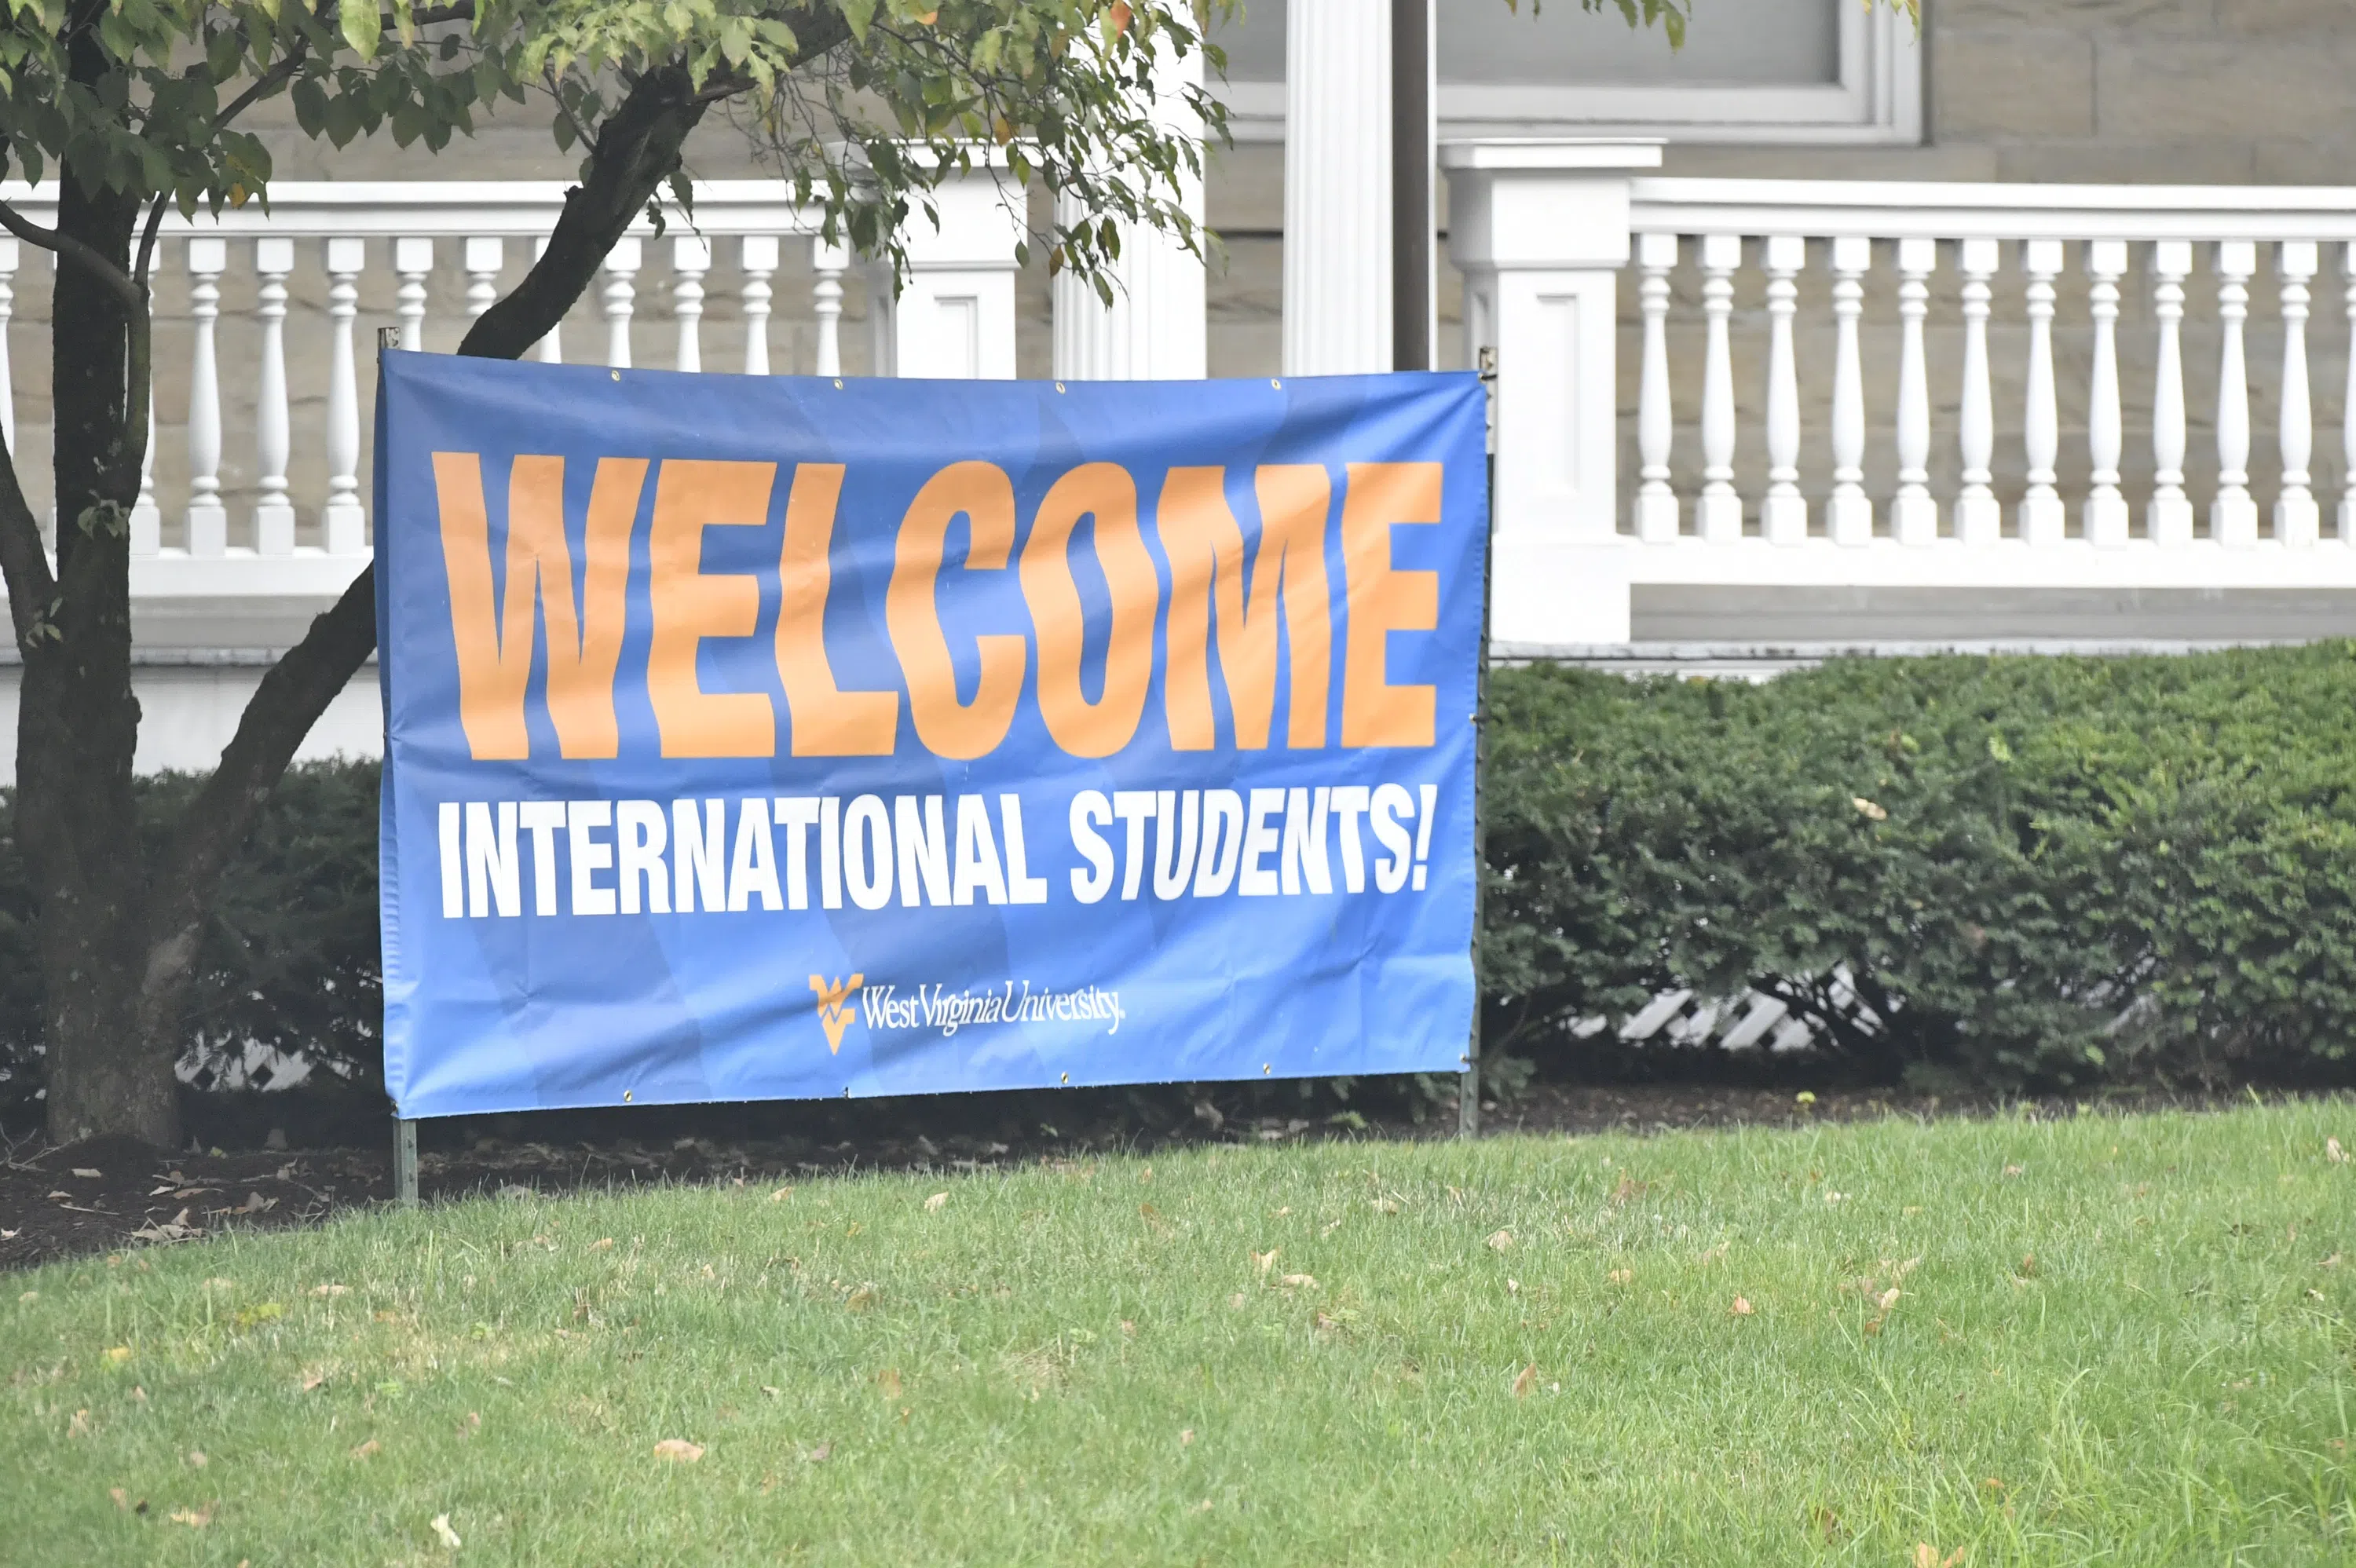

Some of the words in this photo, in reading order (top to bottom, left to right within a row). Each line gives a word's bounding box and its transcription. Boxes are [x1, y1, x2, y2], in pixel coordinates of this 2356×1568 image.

[432, 452, 1443, 759] WELCOME
[438, 794, 1047, 919] INTERNATIONAL
[1070, 784, 1437, 902] STUDENTS!
[863, 985, 919, 1029] West
[920, 983, 1003, 1036] Virginia
